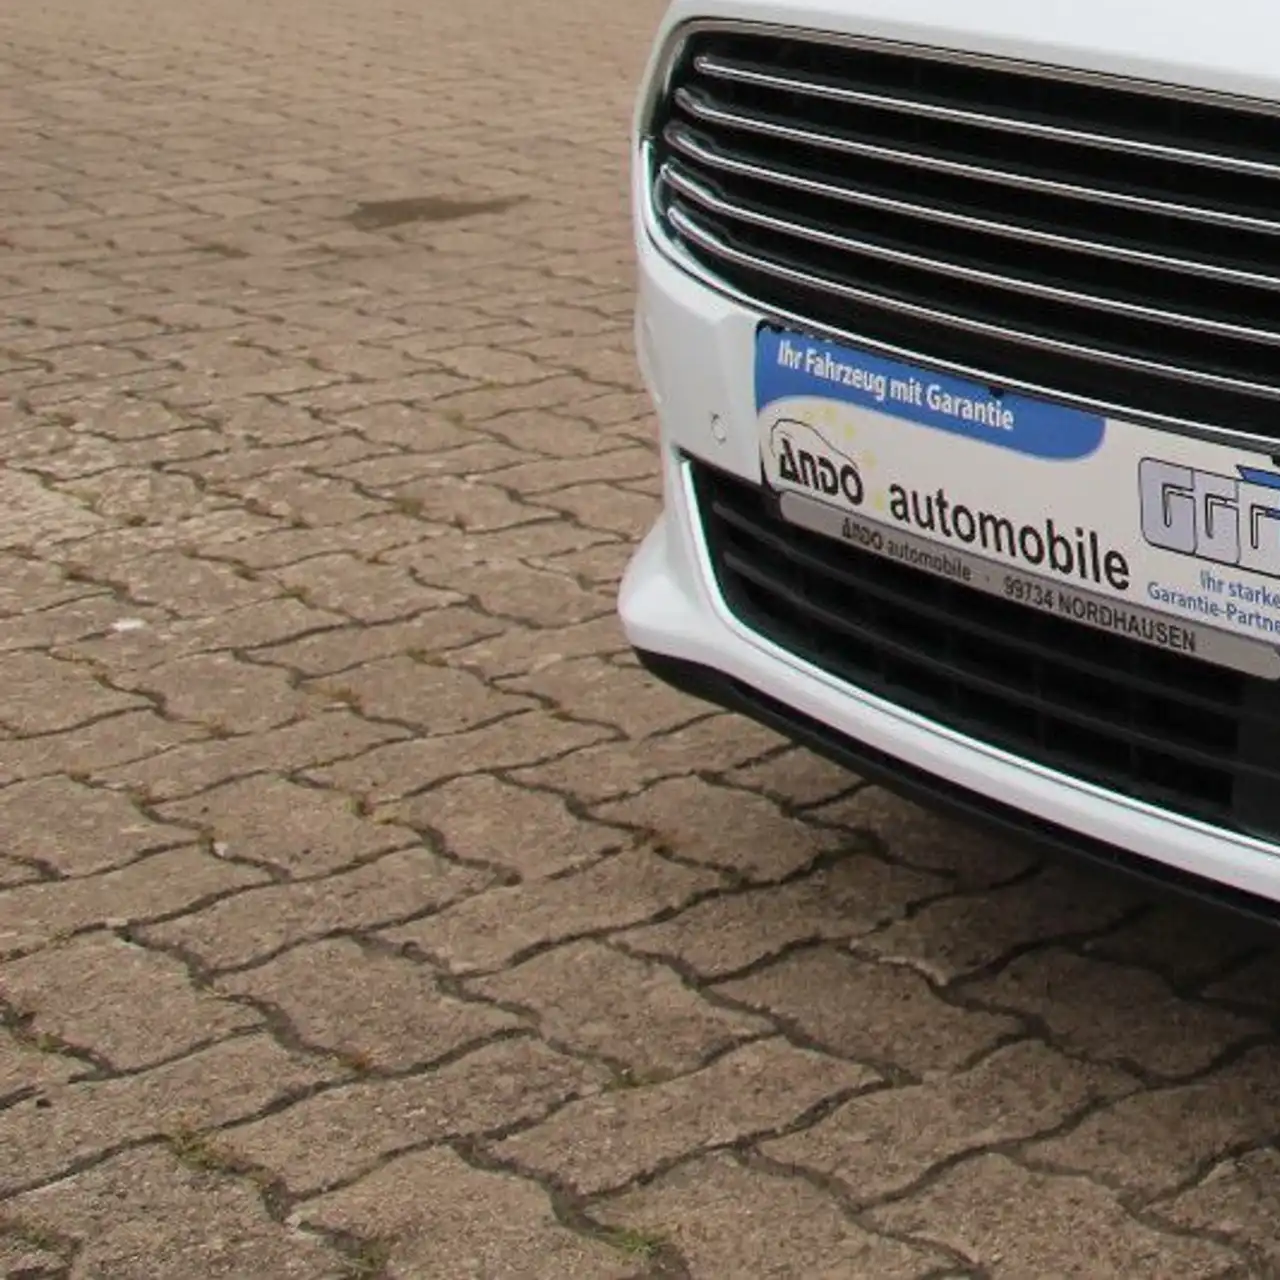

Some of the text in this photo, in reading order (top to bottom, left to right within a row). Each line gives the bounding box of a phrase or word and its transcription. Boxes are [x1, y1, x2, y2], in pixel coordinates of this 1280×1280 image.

[777, 338, 1015, 431] Ihr Fahrzeug mit Garantie
[779, 437, 1131, 591] ANDO automobile
[887, 537, 972, 582] automobile
[1002, 574, 1053, 609] 99734
[1058, 590, 1197, 652] NORDHAUSEN
[1200, 569, 1225, 594] Ihr
